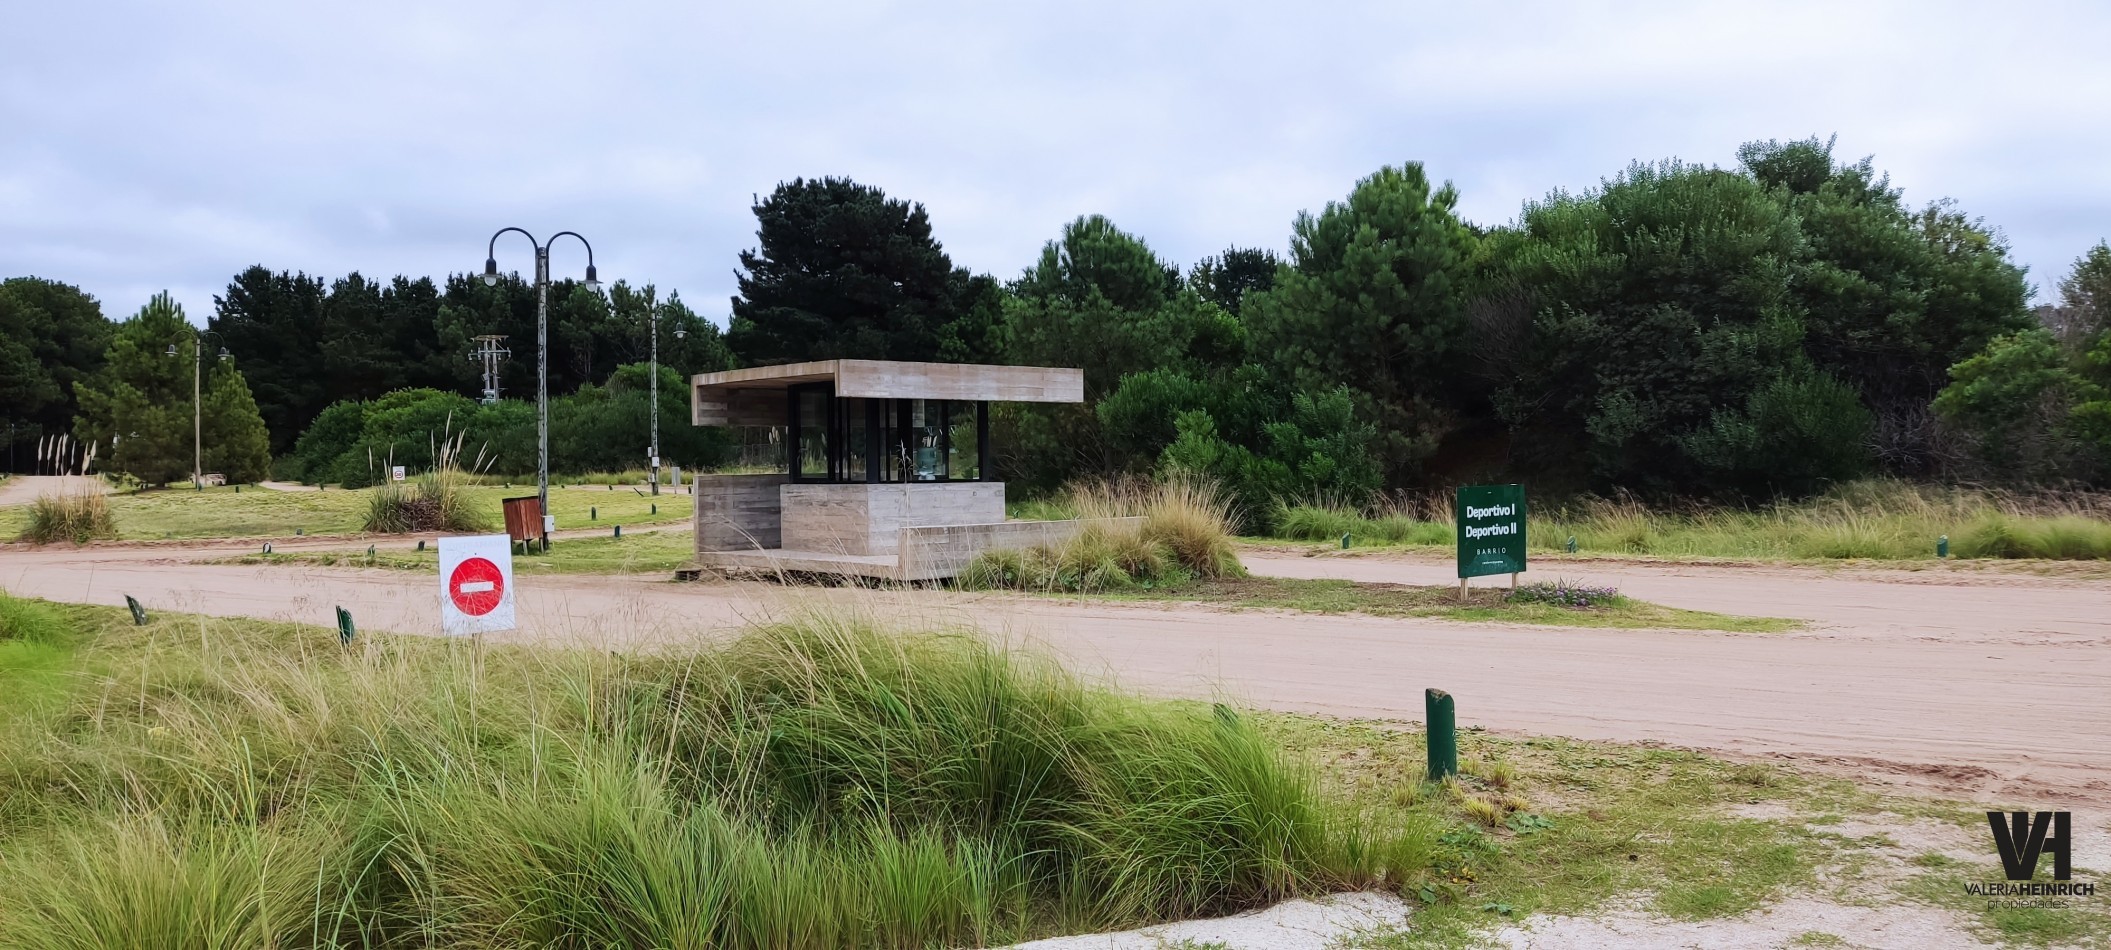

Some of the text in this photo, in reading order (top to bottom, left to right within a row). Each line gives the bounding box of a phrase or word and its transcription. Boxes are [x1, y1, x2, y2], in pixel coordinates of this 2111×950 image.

[1466, 503, 1515, 520] Deportivo I
[1465, 522, 1517, 540] Deportivo II
[1476, 547, 1507, 555] BARRIO
